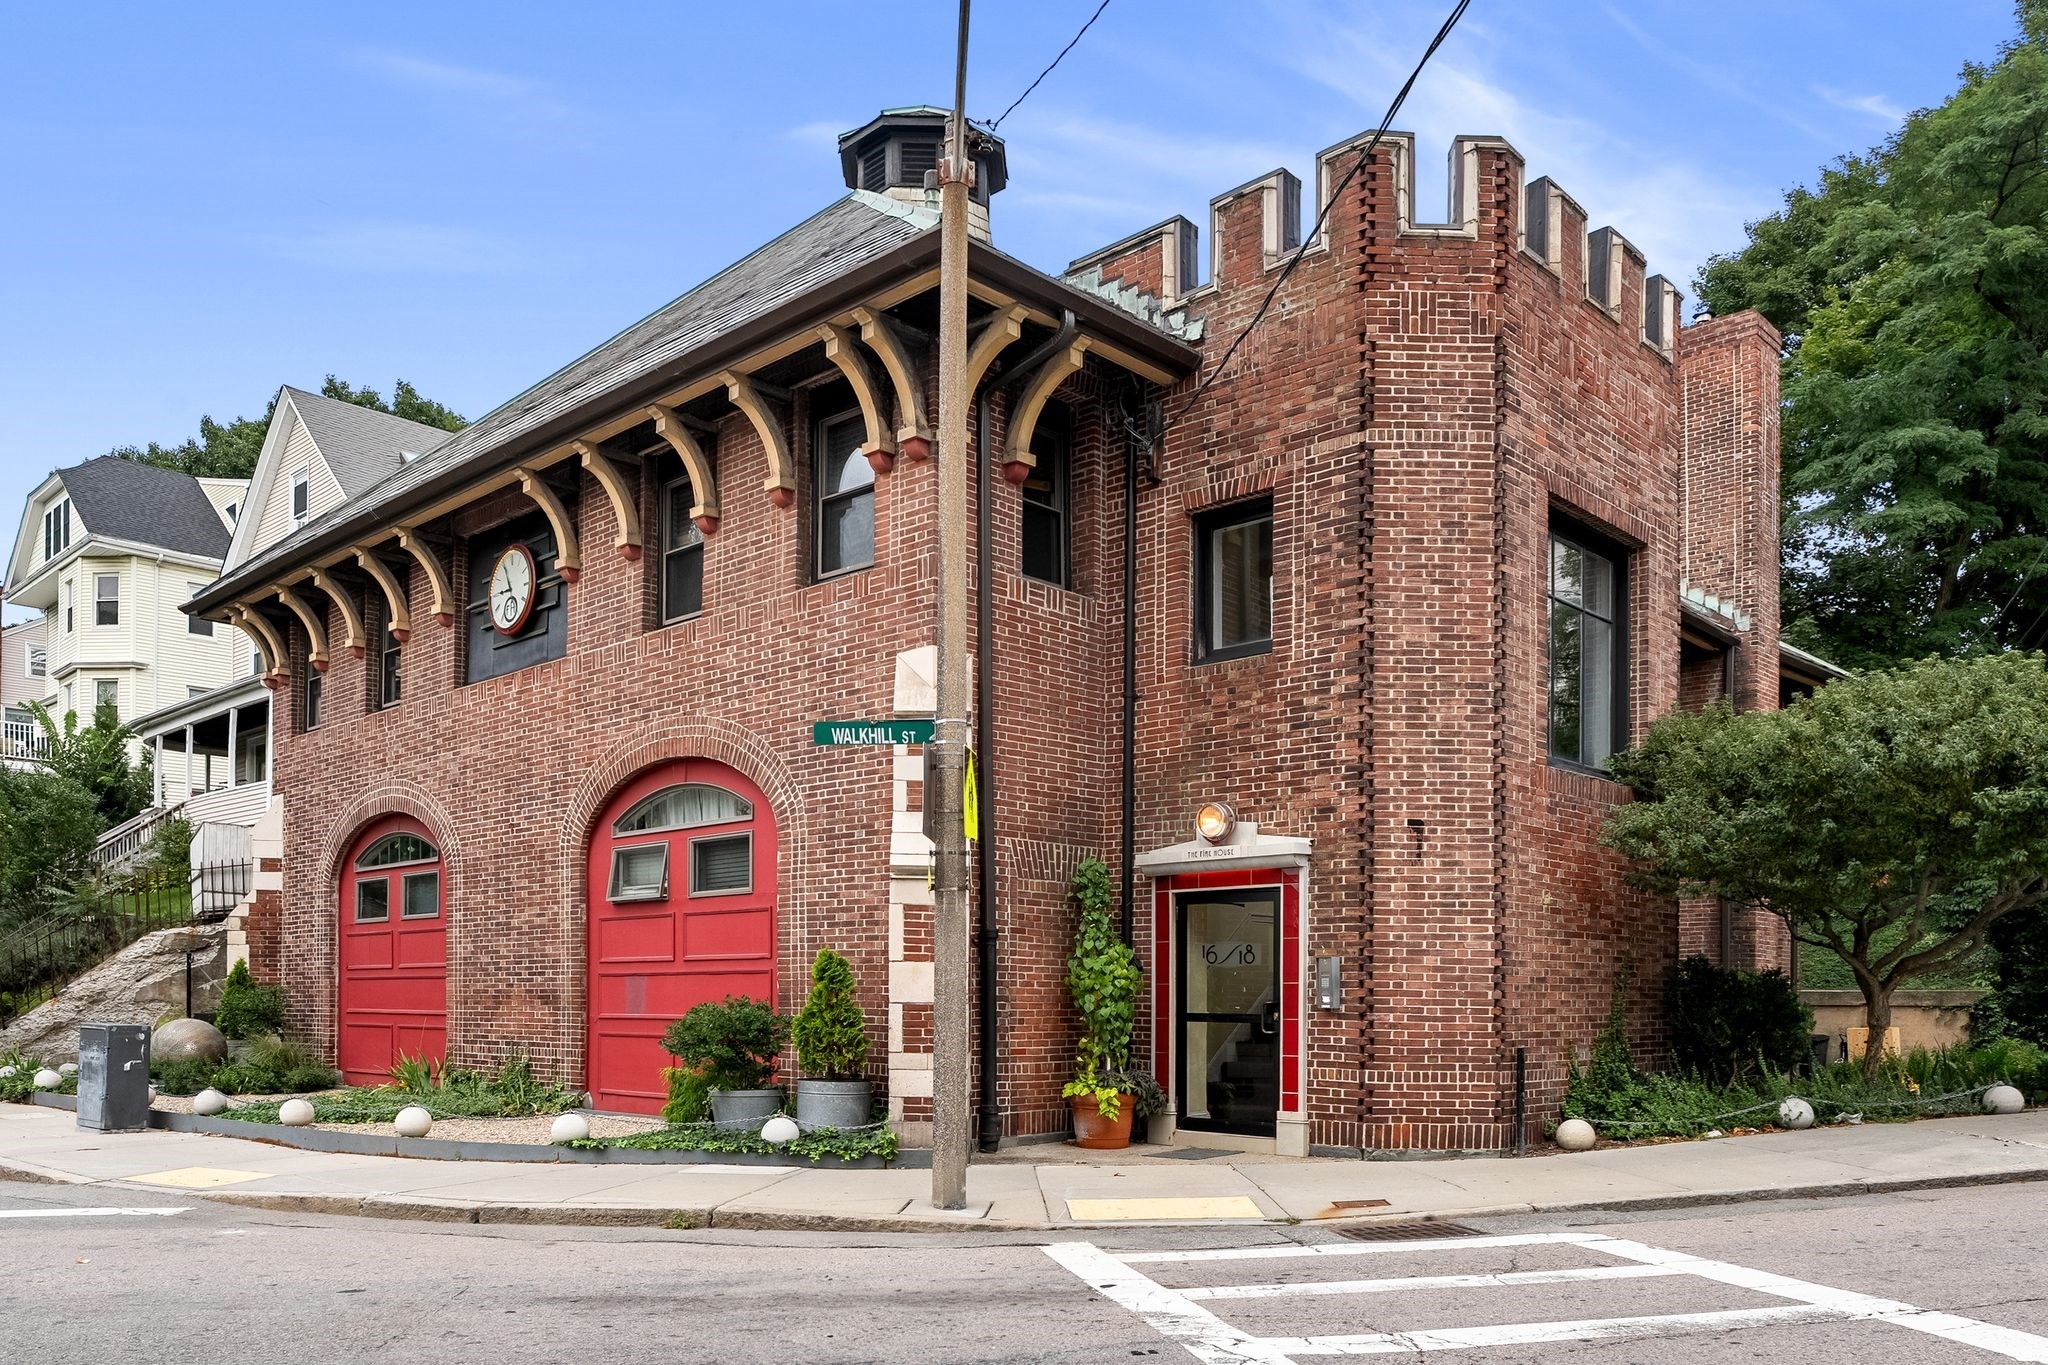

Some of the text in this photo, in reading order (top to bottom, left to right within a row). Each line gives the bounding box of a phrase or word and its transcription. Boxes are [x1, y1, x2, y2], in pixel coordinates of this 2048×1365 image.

[831, 727, 916, 745] WALKHILL ST
[1187, 848, 1234, 859] THE FIRE HOUSE
